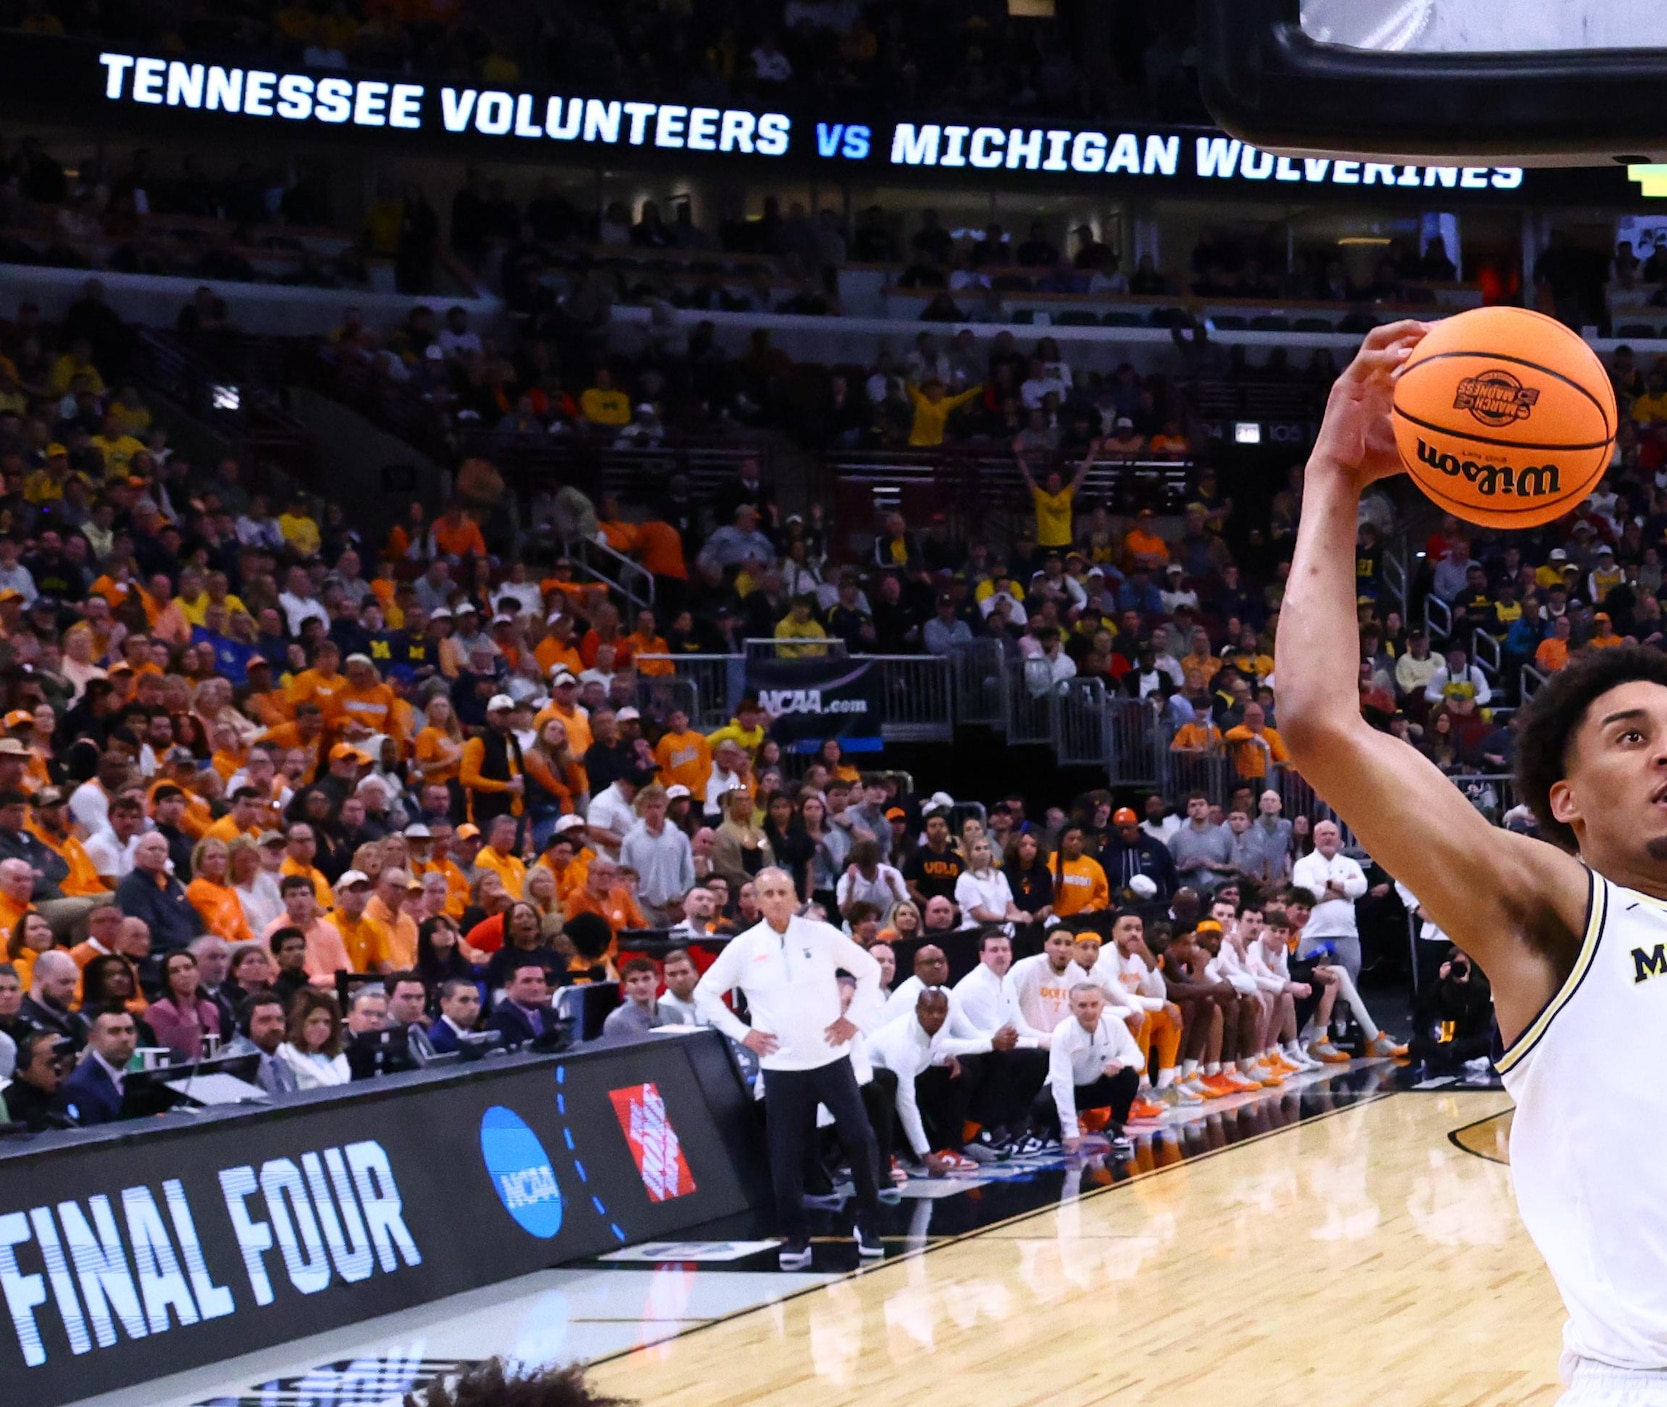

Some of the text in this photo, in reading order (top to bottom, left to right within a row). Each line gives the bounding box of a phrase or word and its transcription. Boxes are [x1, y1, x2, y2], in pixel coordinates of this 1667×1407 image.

[99, 52, 425, 130] TENNESSEE
[441, 86, 791, 156] VOLUNTEERS
[816, 122, 871, 160] VS
[891, 123, 1180, 176] MICHIGAN
[1416, 437, 1562, 498] Wilson
[758, 688, 868, 716] NCAA.com
[500, 1164, 560, 1210] NCAA
[0, 1178, 236, 1368] FINAL
[217, 1139, 423, 1307] FOUR
